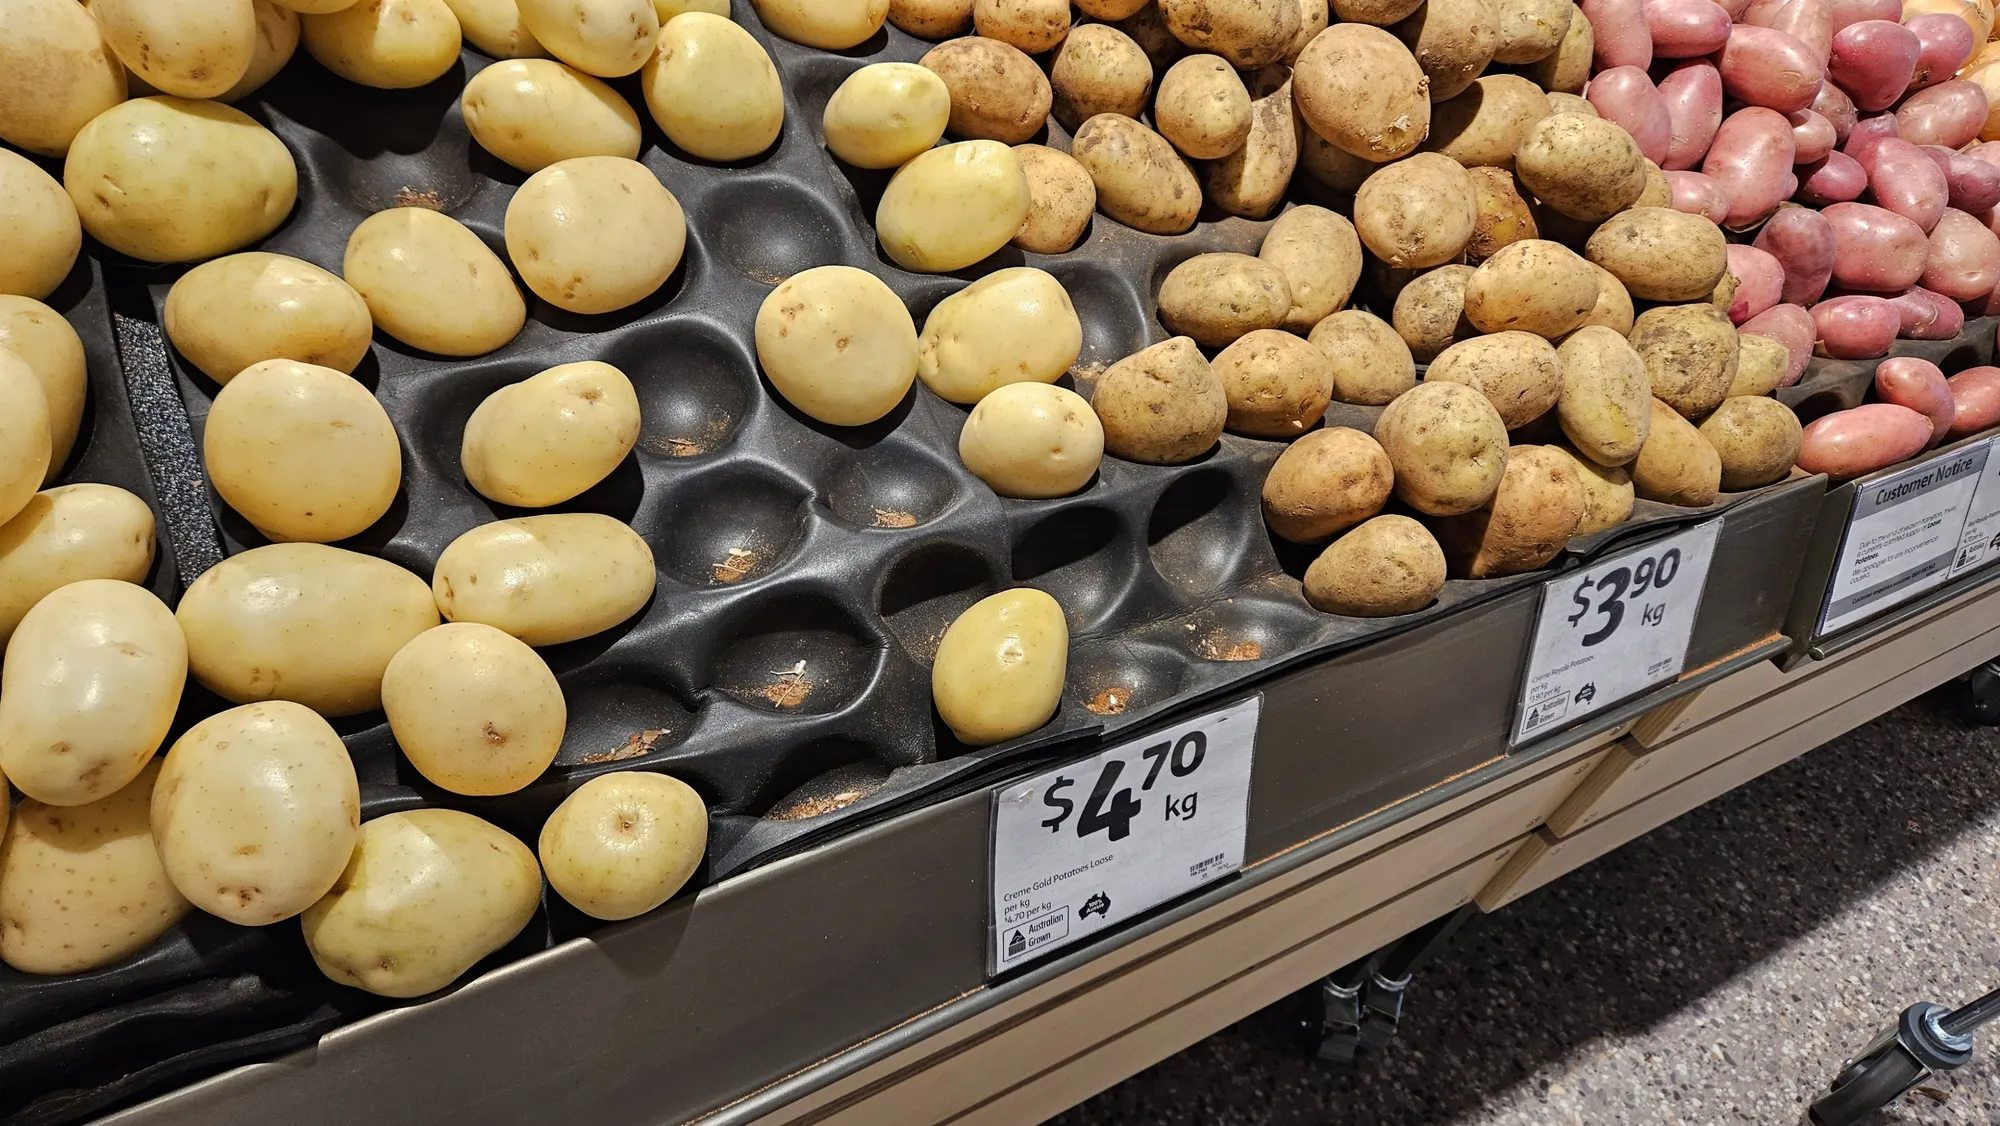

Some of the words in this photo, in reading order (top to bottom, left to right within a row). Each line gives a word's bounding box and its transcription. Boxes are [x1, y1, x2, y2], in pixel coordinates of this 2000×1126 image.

[1875, 473, 1935, 505] Customer
[1935, 458, 1973, 482] Notice
[1641, 603, 1666, 627] kg
[1570, 655, 1594, 667] Potatoes
[1530, 685, 1540, 695] per
[1541, 682, 1548, 690] kg
[1544, 688, 1554, 698] per
[1165, 791, 1198, 822] kg
[1003, 886, 1031, 902] Creme
[1032, 876, 1052, 891] Gold
[1053, 863, 1089, 883] Potatoes
[1090, 854, 1114, 868] Loose
[1004, 903, 1018, 916] per
[1020, 898, 1030, 909] kg
[1004, 912, 1025, 924] $4.70
[1026, 906, 1040, 919] per
[1041, 901, 1052, 911] kg
[1028, 913, 1064, 935] Australian
[1028, 932, 1051, 947] Grown
